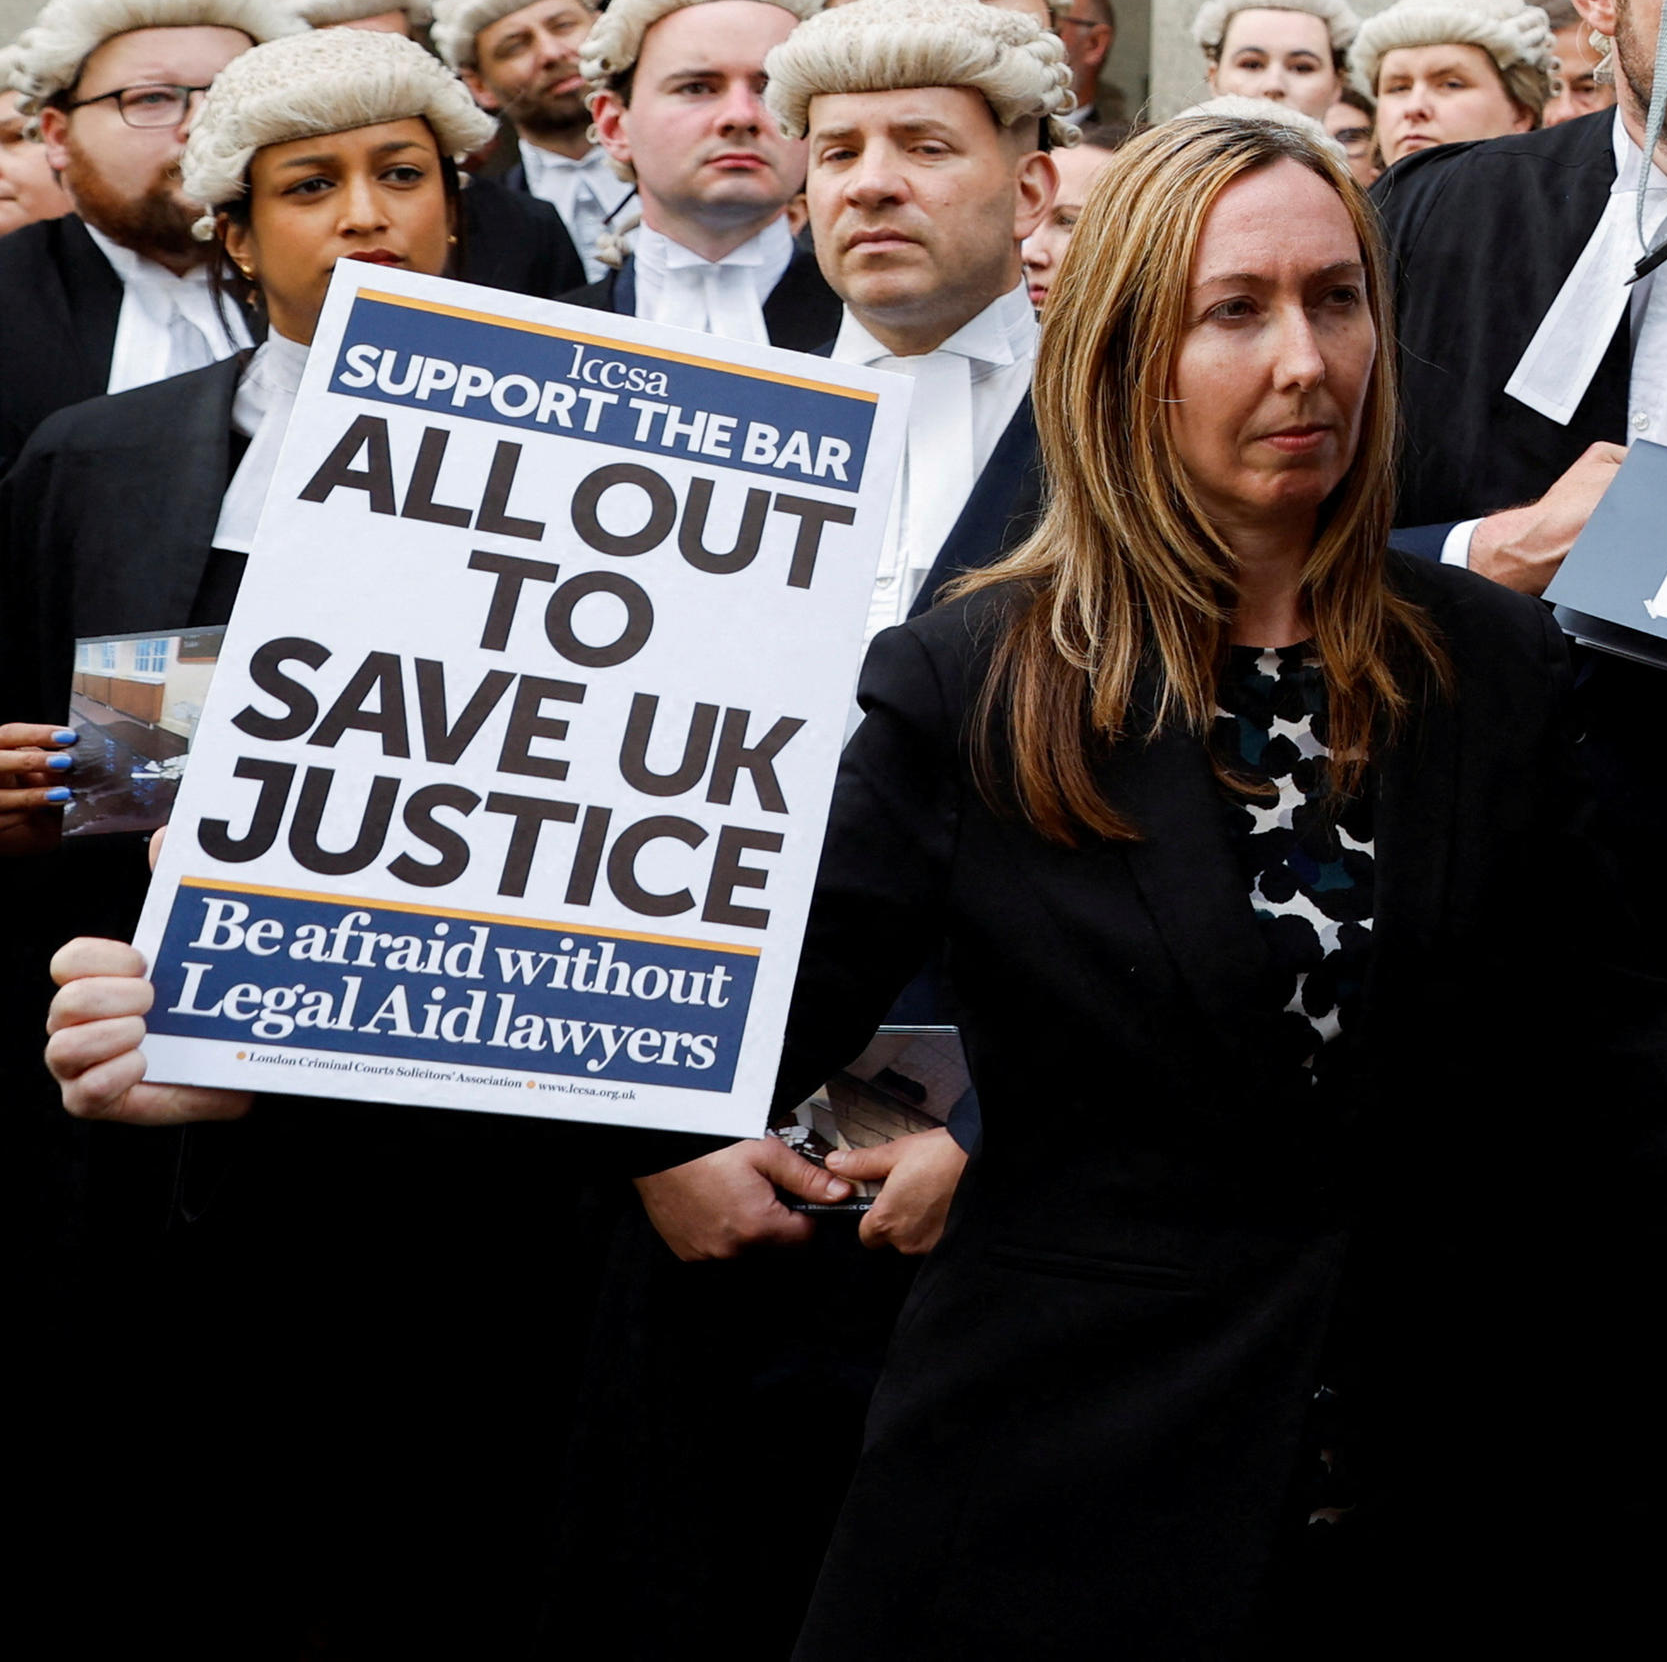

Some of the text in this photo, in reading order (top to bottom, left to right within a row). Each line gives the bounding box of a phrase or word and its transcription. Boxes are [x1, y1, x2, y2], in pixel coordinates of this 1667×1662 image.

[338, 344, 851, 481] SUPPORT THE BAR
[568, 344, 668, 398] lccsa
[299, 415, 857, 589] ALL OUT
[467, 550, 654, 668] TO
[231, 638, 807, 815] SAVE UK
[197, 758, 785, 929] JUSTICE
[190, 899, 733, 1009] Be afraid without
[167, 963, 718, 1072] Legal Aid lawyers
[249, 1052, 296, 1066] London
[299, 1058, 353, 1071] Criminal
[354, 1062, 395, 1075] Courts
[456, 1073, 522, 1089] Association
[538, 1082, 636, 1101] www.lccsa.org.uk
